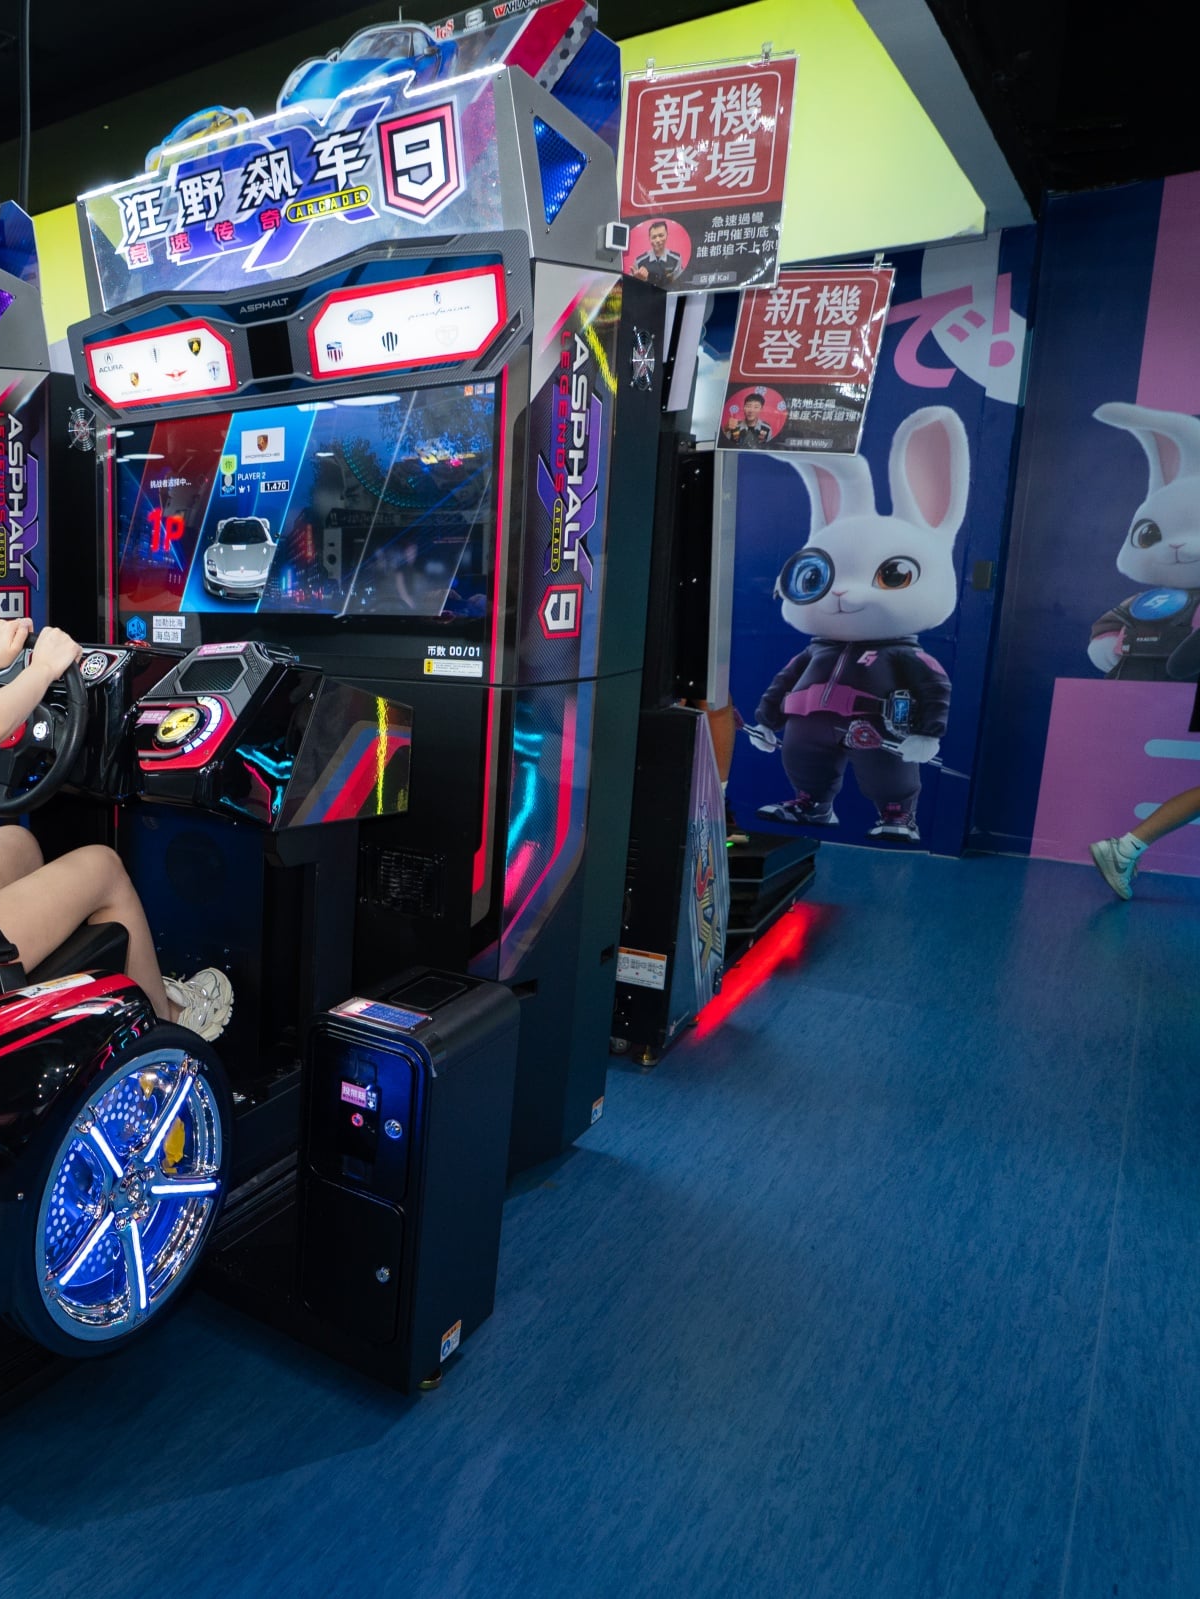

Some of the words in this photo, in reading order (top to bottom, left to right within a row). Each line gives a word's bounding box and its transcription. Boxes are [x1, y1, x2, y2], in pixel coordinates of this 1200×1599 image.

[652, 82, 762, 143] 新機
[127, 132, 366, 244] 狂野飙车
[392, 121, 446, 203] 9
[648, 138, 757, 197] 登場
[295, 191, 362, 219] ARCADE
[128, 208, 282, 265] 竞速传奇
[704, 225, 769, 244] 油門催到底
[239, 297, 289, 315] ASPHALT
[763, 285, 862, 325] 新機
[99, 363, 124, 373] ACURA
[755, 329, 851, 370] 登場
[554, 331, 572, 493] LEGENDS
[237, 473, 260, 481] PLAYER
[260, 472, 266, 480] 2
[564, 333, 589, 572] ASPHALT
[7, 413, 24, 578] ASPHALT
[552, 506, 562, 568] ARCADE
[427, 645, 446, 657] 币数
[449, 646, 480, 657] 00/01
